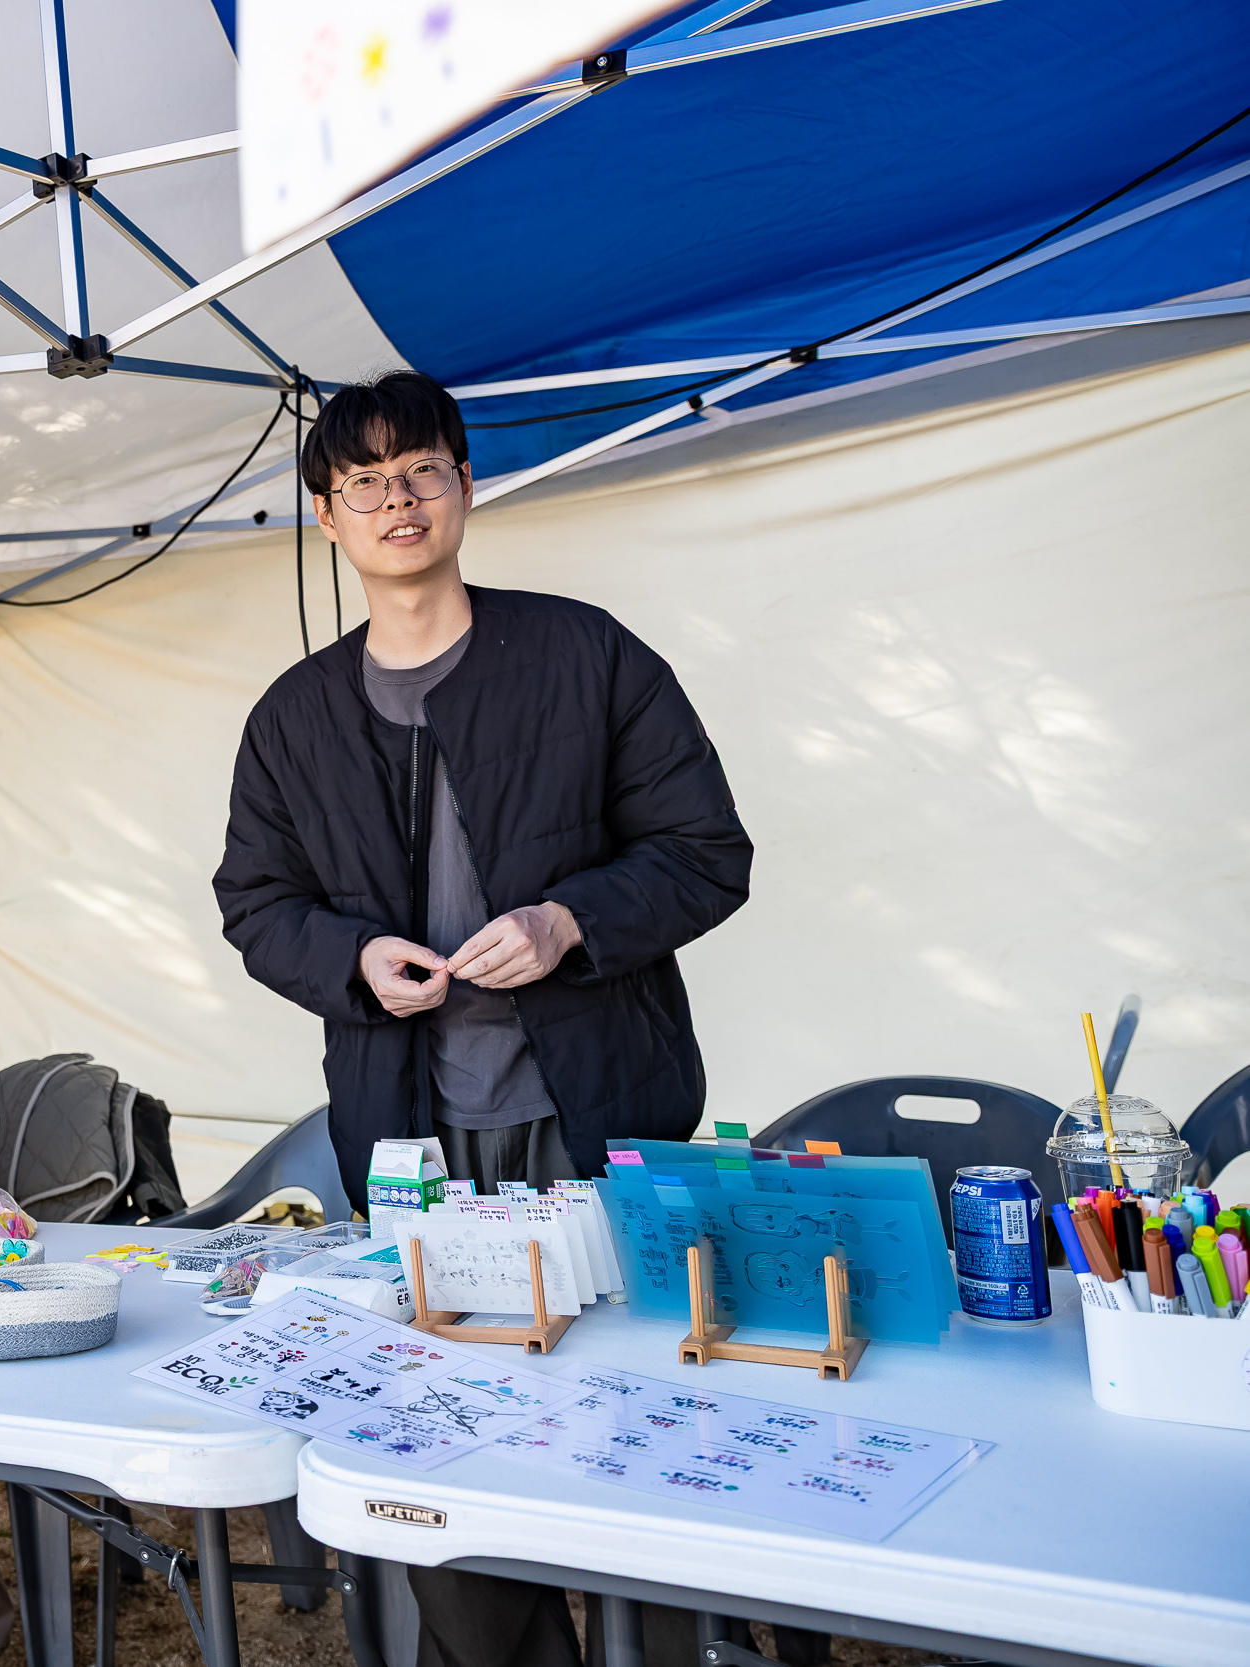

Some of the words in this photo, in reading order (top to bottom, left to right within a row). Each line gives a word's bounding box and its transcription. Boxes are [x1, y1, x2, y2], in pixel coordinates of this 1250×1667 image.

[951, 1182, 982, 1197] PEPSI
[242, 1330, 284, 1351] 매일매일
[181, 1354, 205, 1364] MY
[161, 1360, 224, 1385] ECO
[196, 1381, 231, 1395] BAG
[300, 1377, 345, 1393] PRETTY
[344, 1393, 369, 1402] CAT
[374, 1504, 437, 1524] LIFETIME
